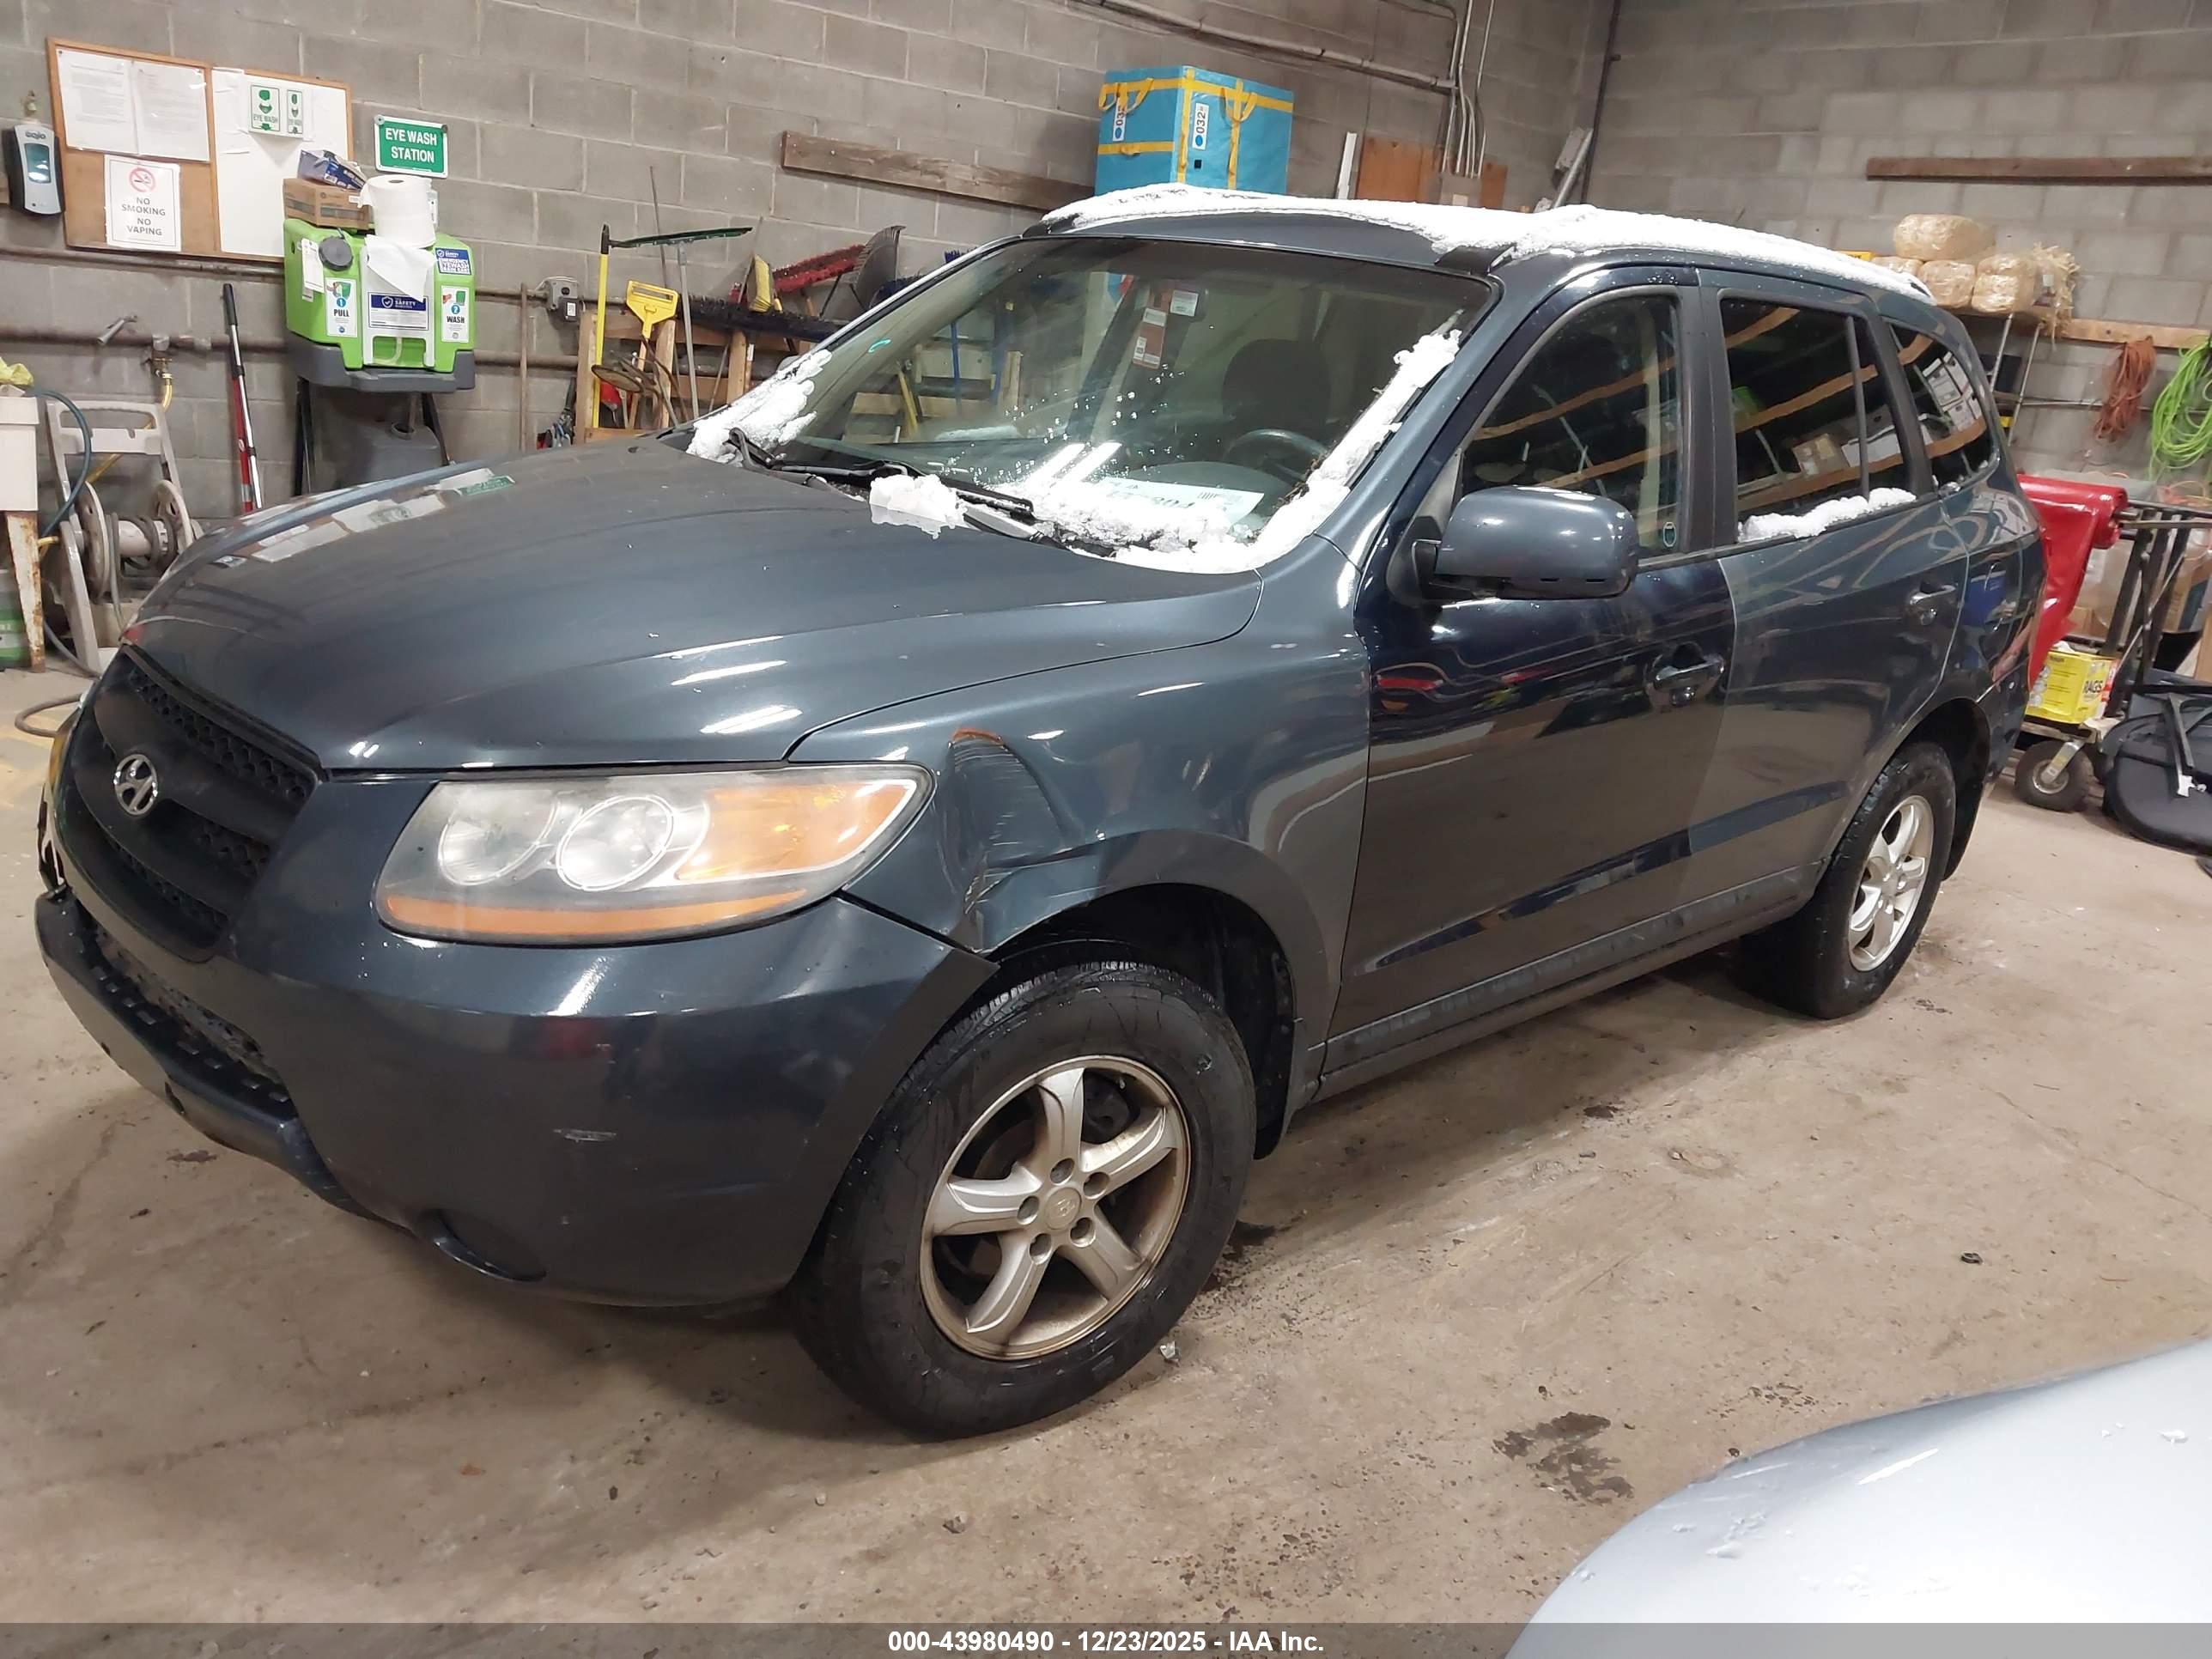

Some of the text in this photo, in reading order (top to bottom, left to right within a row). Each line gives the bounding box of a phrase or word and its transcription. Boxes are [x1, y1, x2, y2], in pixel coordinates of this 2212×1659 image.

[1195, 112, 1206, 134] 032
[385, 127, 437, 146] EYE WASH
[391, 145, 434, 163] STATION
[137, 197, 150, 205] NO
[121, 204, 166, 216] SMOKING
[137, 217, 151, 226] NO
[126, 225, 163, 236] VAPING
[333, 308, 350, 318] PULL
[447, 315, 465, 324] WASH
